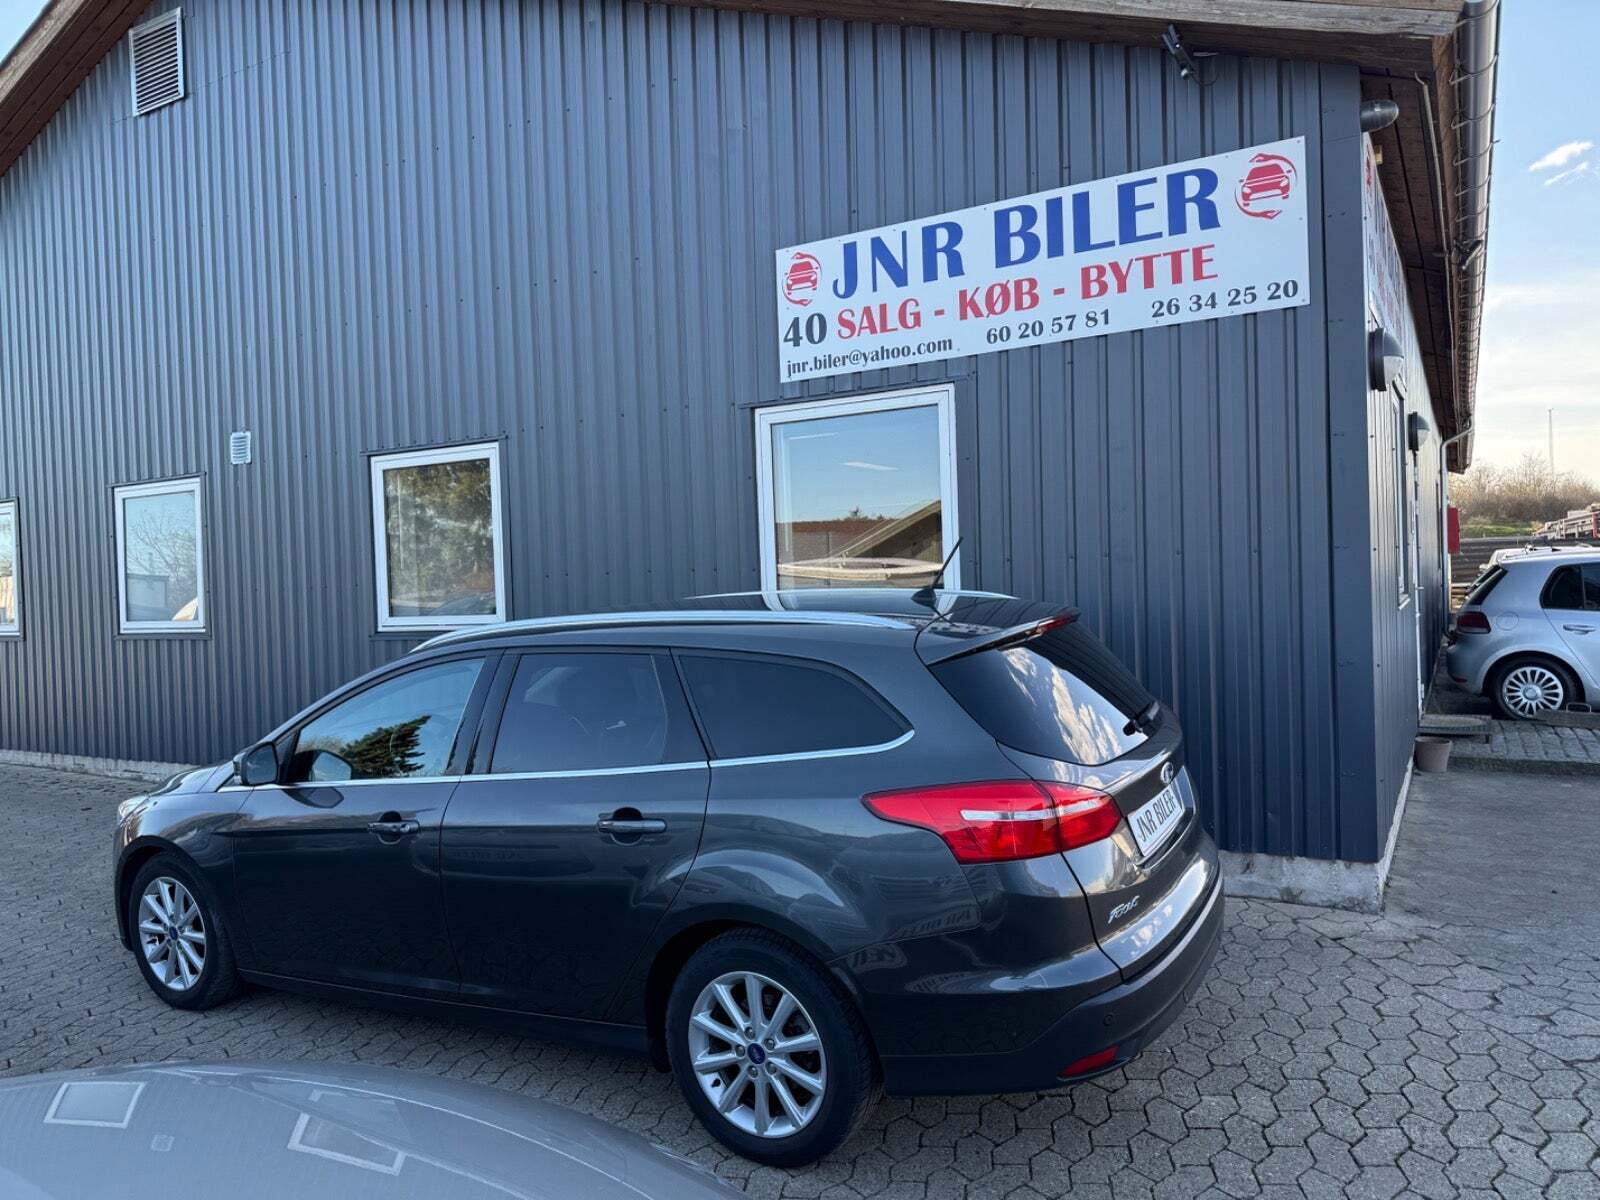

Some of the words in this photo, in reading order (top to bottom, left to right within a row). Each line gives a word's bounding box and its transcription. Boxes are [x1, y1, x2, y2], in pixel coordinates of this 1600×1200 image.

[832, 221, 966, 300] JNR
[993, 167, 1222, 270] BILER
[836, 297, 922, 340] SALG
[934, 308, 945, 317] -
[958, 276, 1040, 321] KØB
[1053, 287, 1065, 296] -
[1080, 243, 1219, 300] BYTTE
[1151, 297, 1181, 319] 26
[1188, 291, 1219, 313] 34
[1227, 285, 1258, 308] 25
[1266, 279, 1299, 302] 20
[782, 311, 829, 348] 40
[986, 325, 1012, 345] 60
[1017, 319, 1044, 340] 20
[1051, 313, 1077, 334] 57
[1084, 308, 1111, 329] 81
[786, 337, 953, 379] jnr.biler@yahoo.com
[1136, 809, 1158, 842] JNR
[1152, 789, 1177, 825] BILER
